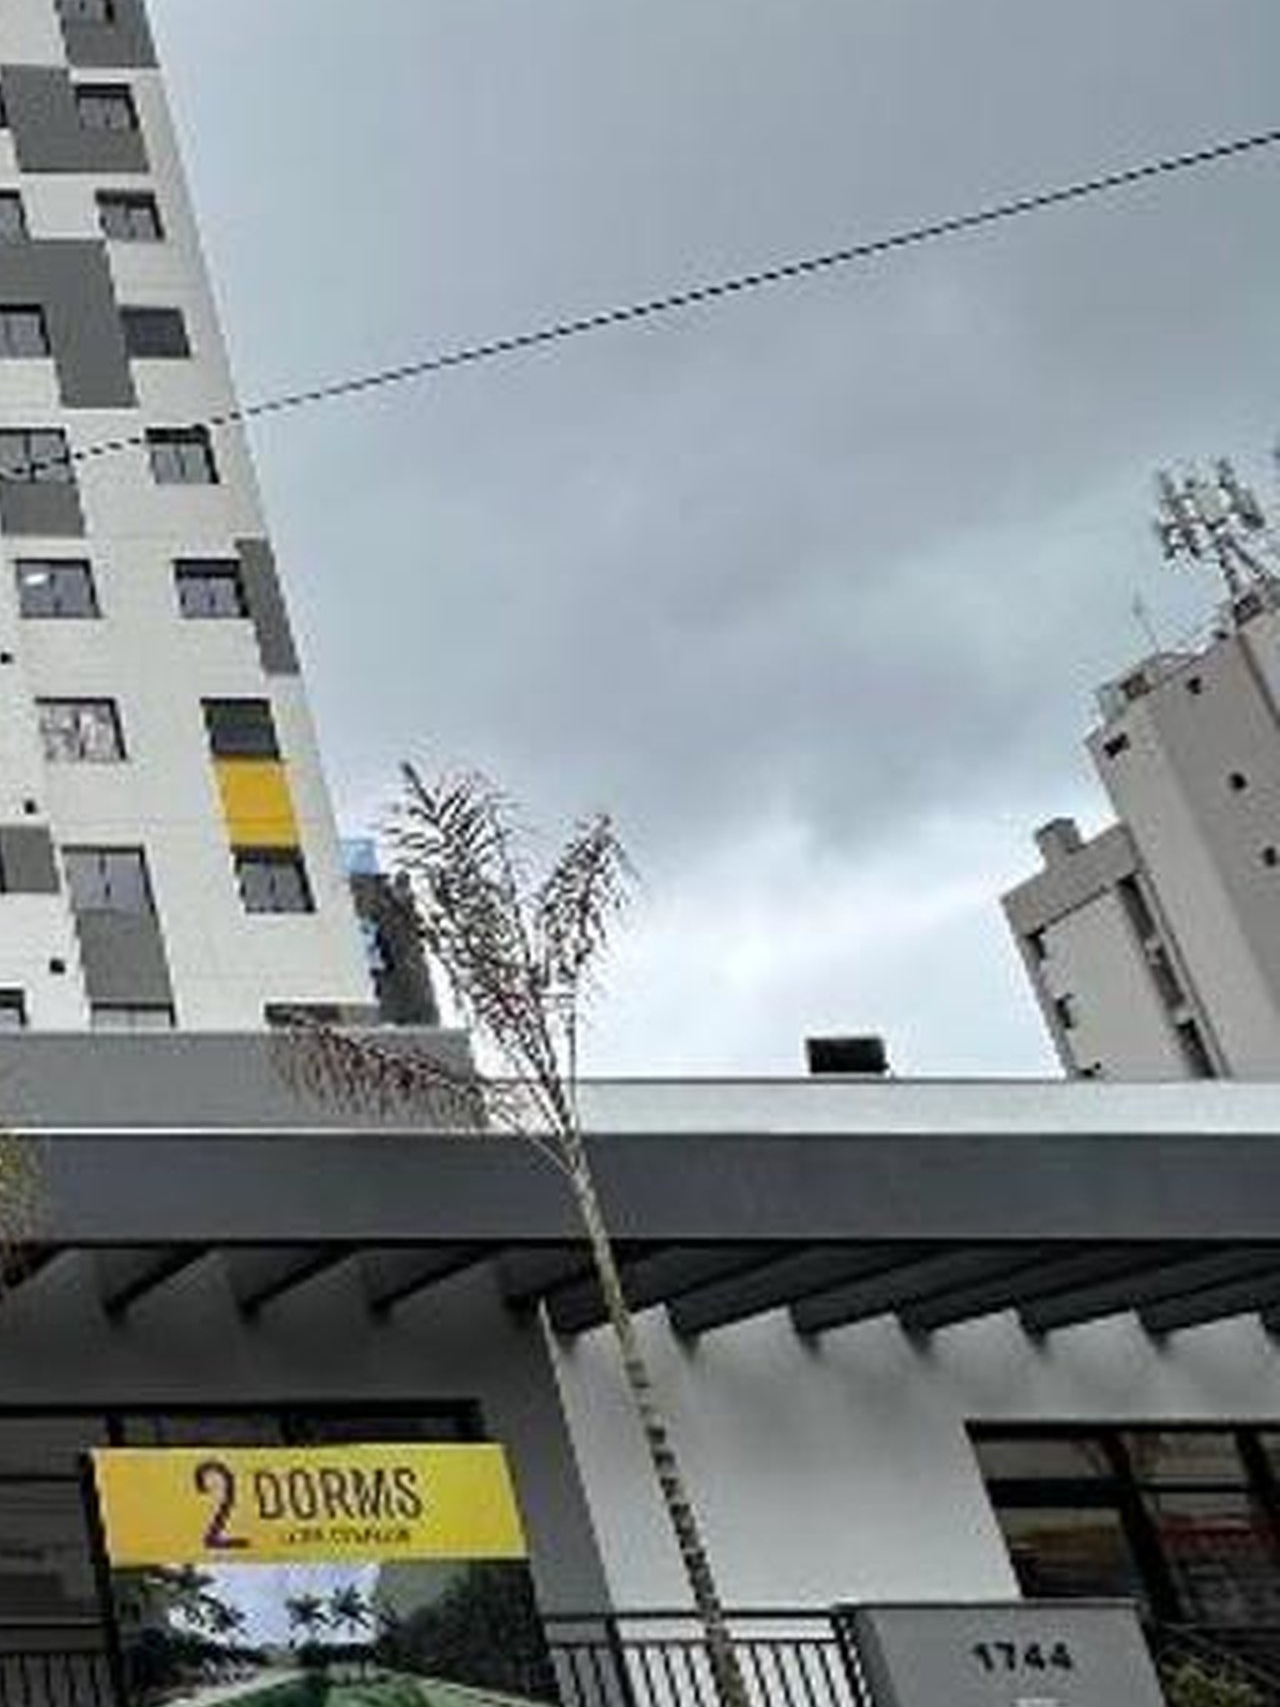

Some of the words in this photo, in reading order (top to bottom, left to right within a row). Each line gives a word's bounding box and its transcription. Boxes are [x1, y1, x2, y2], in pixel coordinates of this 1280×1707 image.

[195, 1461, 250, 1549] 2
[255, 1467, 422, 1520] DORMS
[973, 1641, 1072, 1672] 1744
